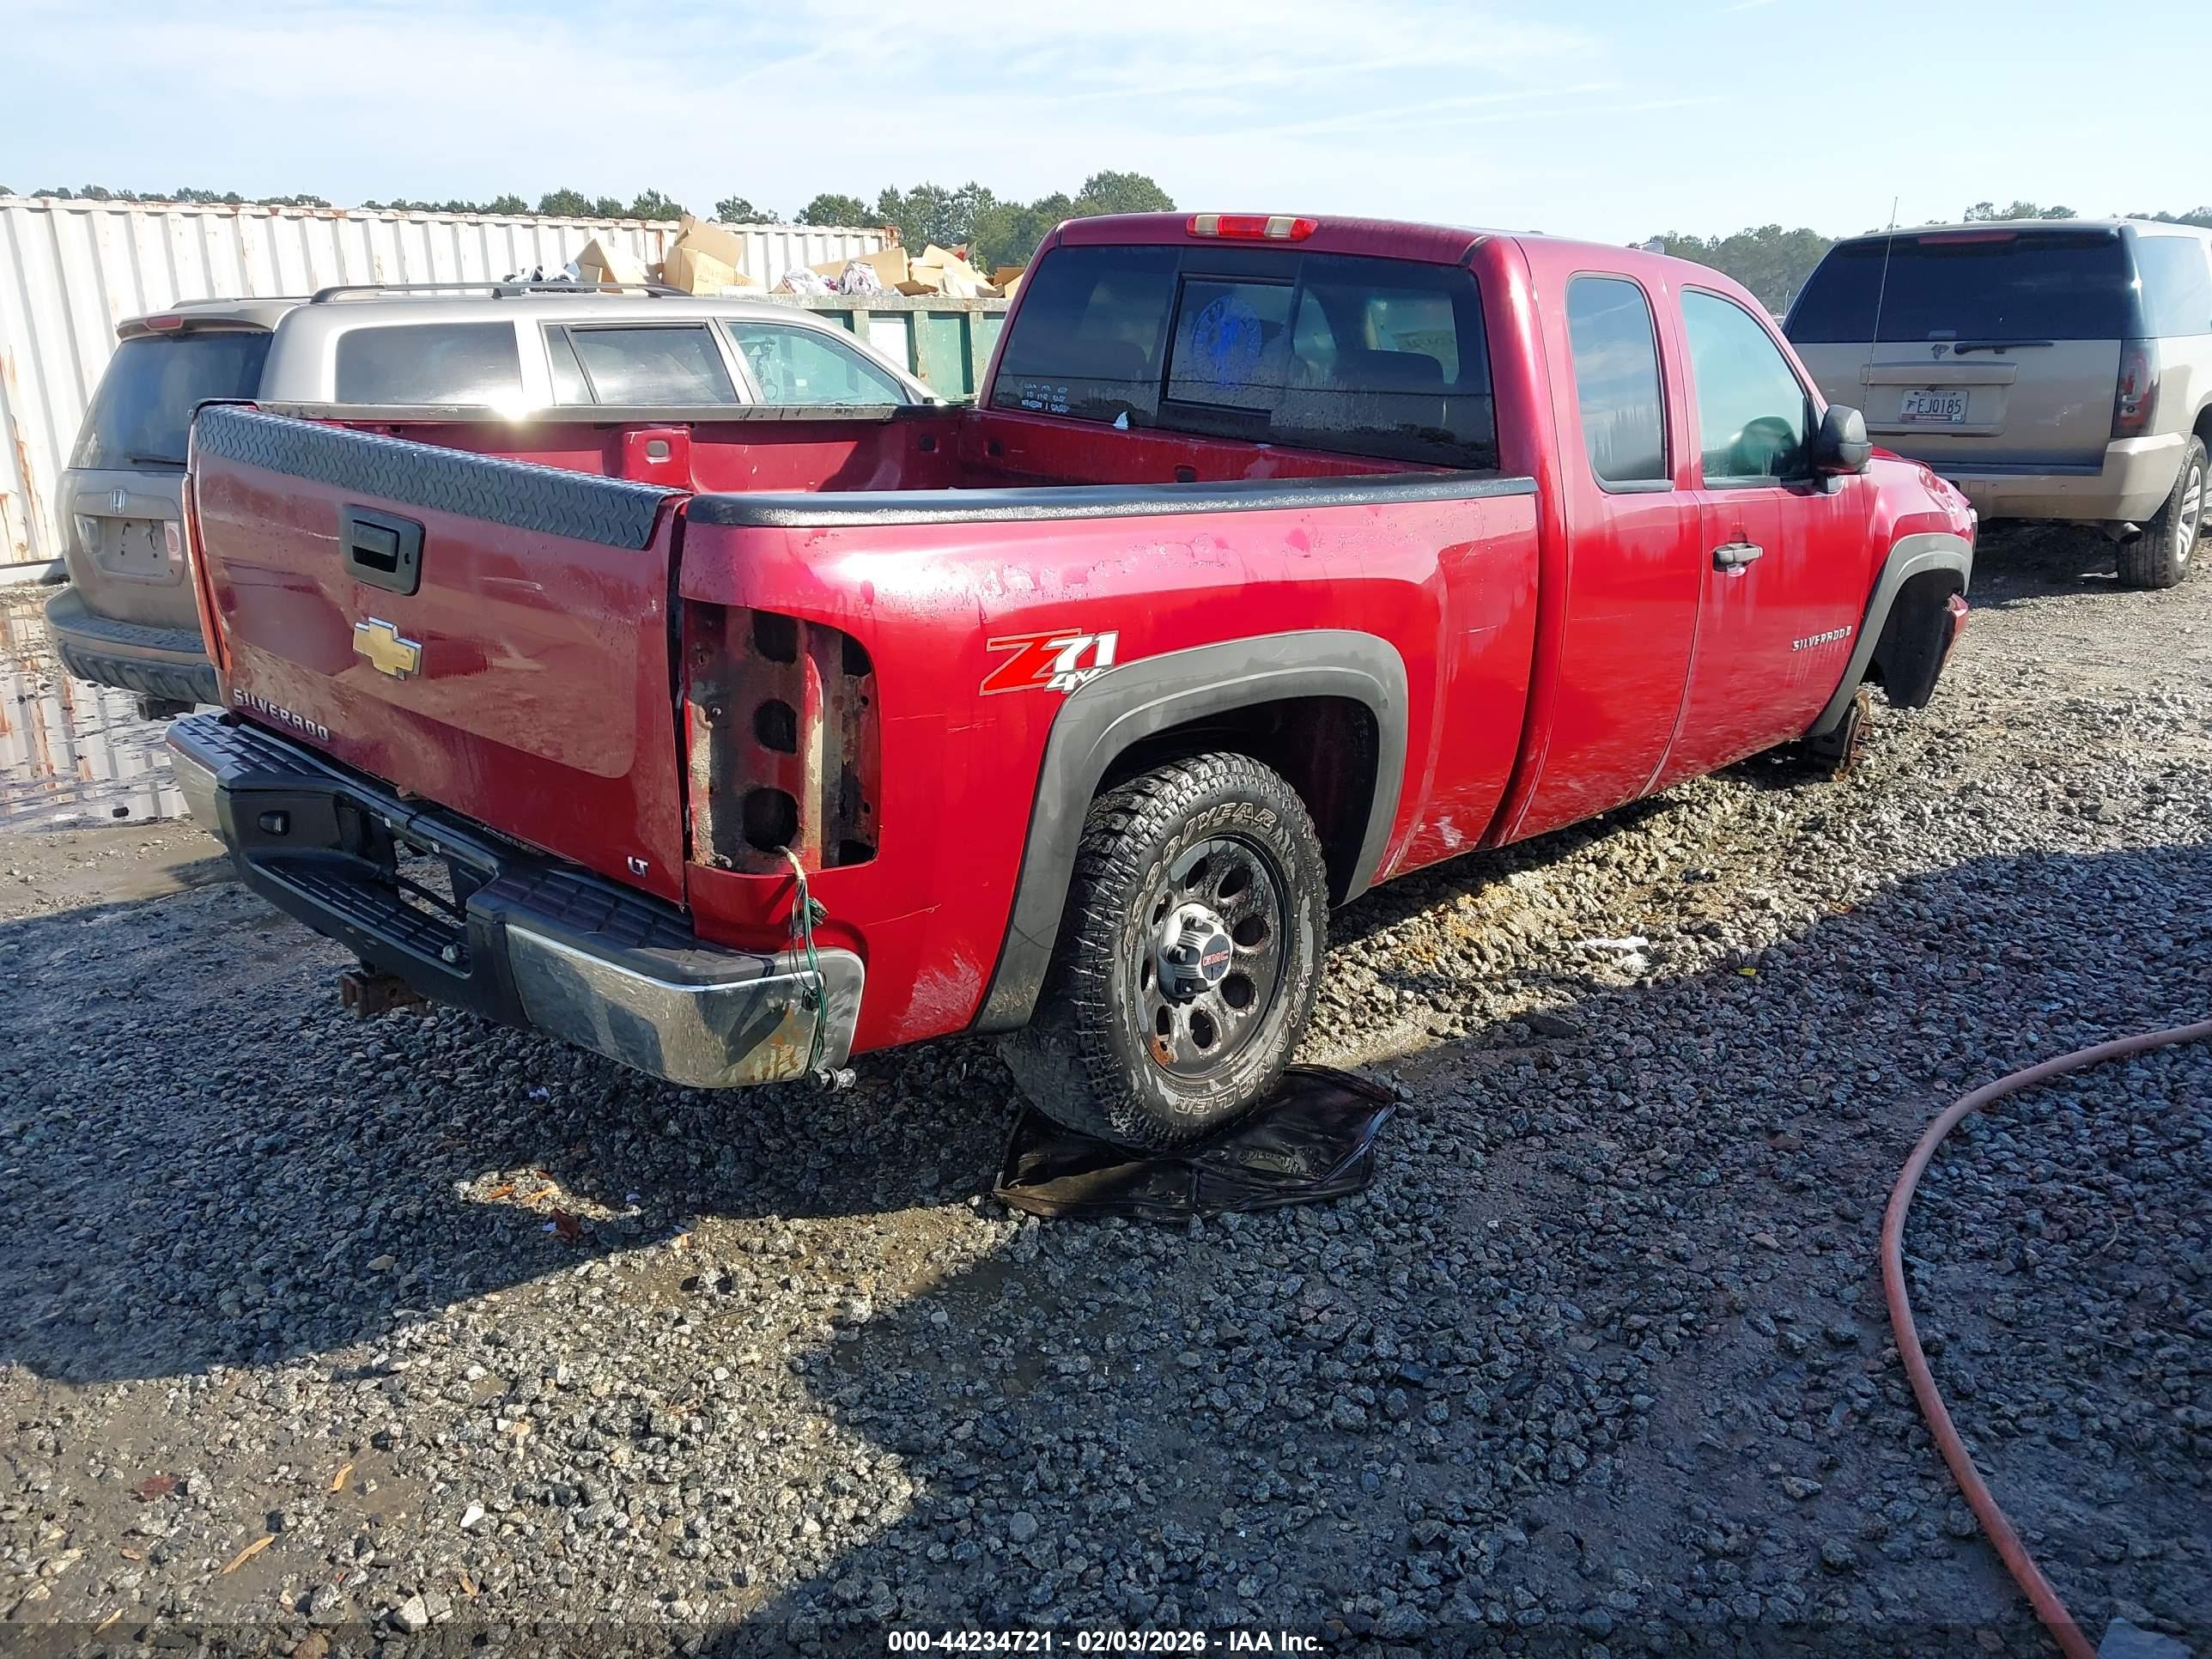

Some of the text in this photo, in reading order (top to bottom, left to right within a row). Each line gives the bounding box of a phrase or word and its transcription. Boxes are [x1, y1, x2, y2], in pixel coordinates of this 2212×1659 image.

[1791, 624, 1853, 653] SILVERADO
[979, 628, 1119, 696] Z71
[233, 688, 330, 742] SILVERADO
[627, 855, 649, 878] LT
[1202, 949, 1229, 967] GMC
[1174, 963, 1314, 1115] WRANGLER
